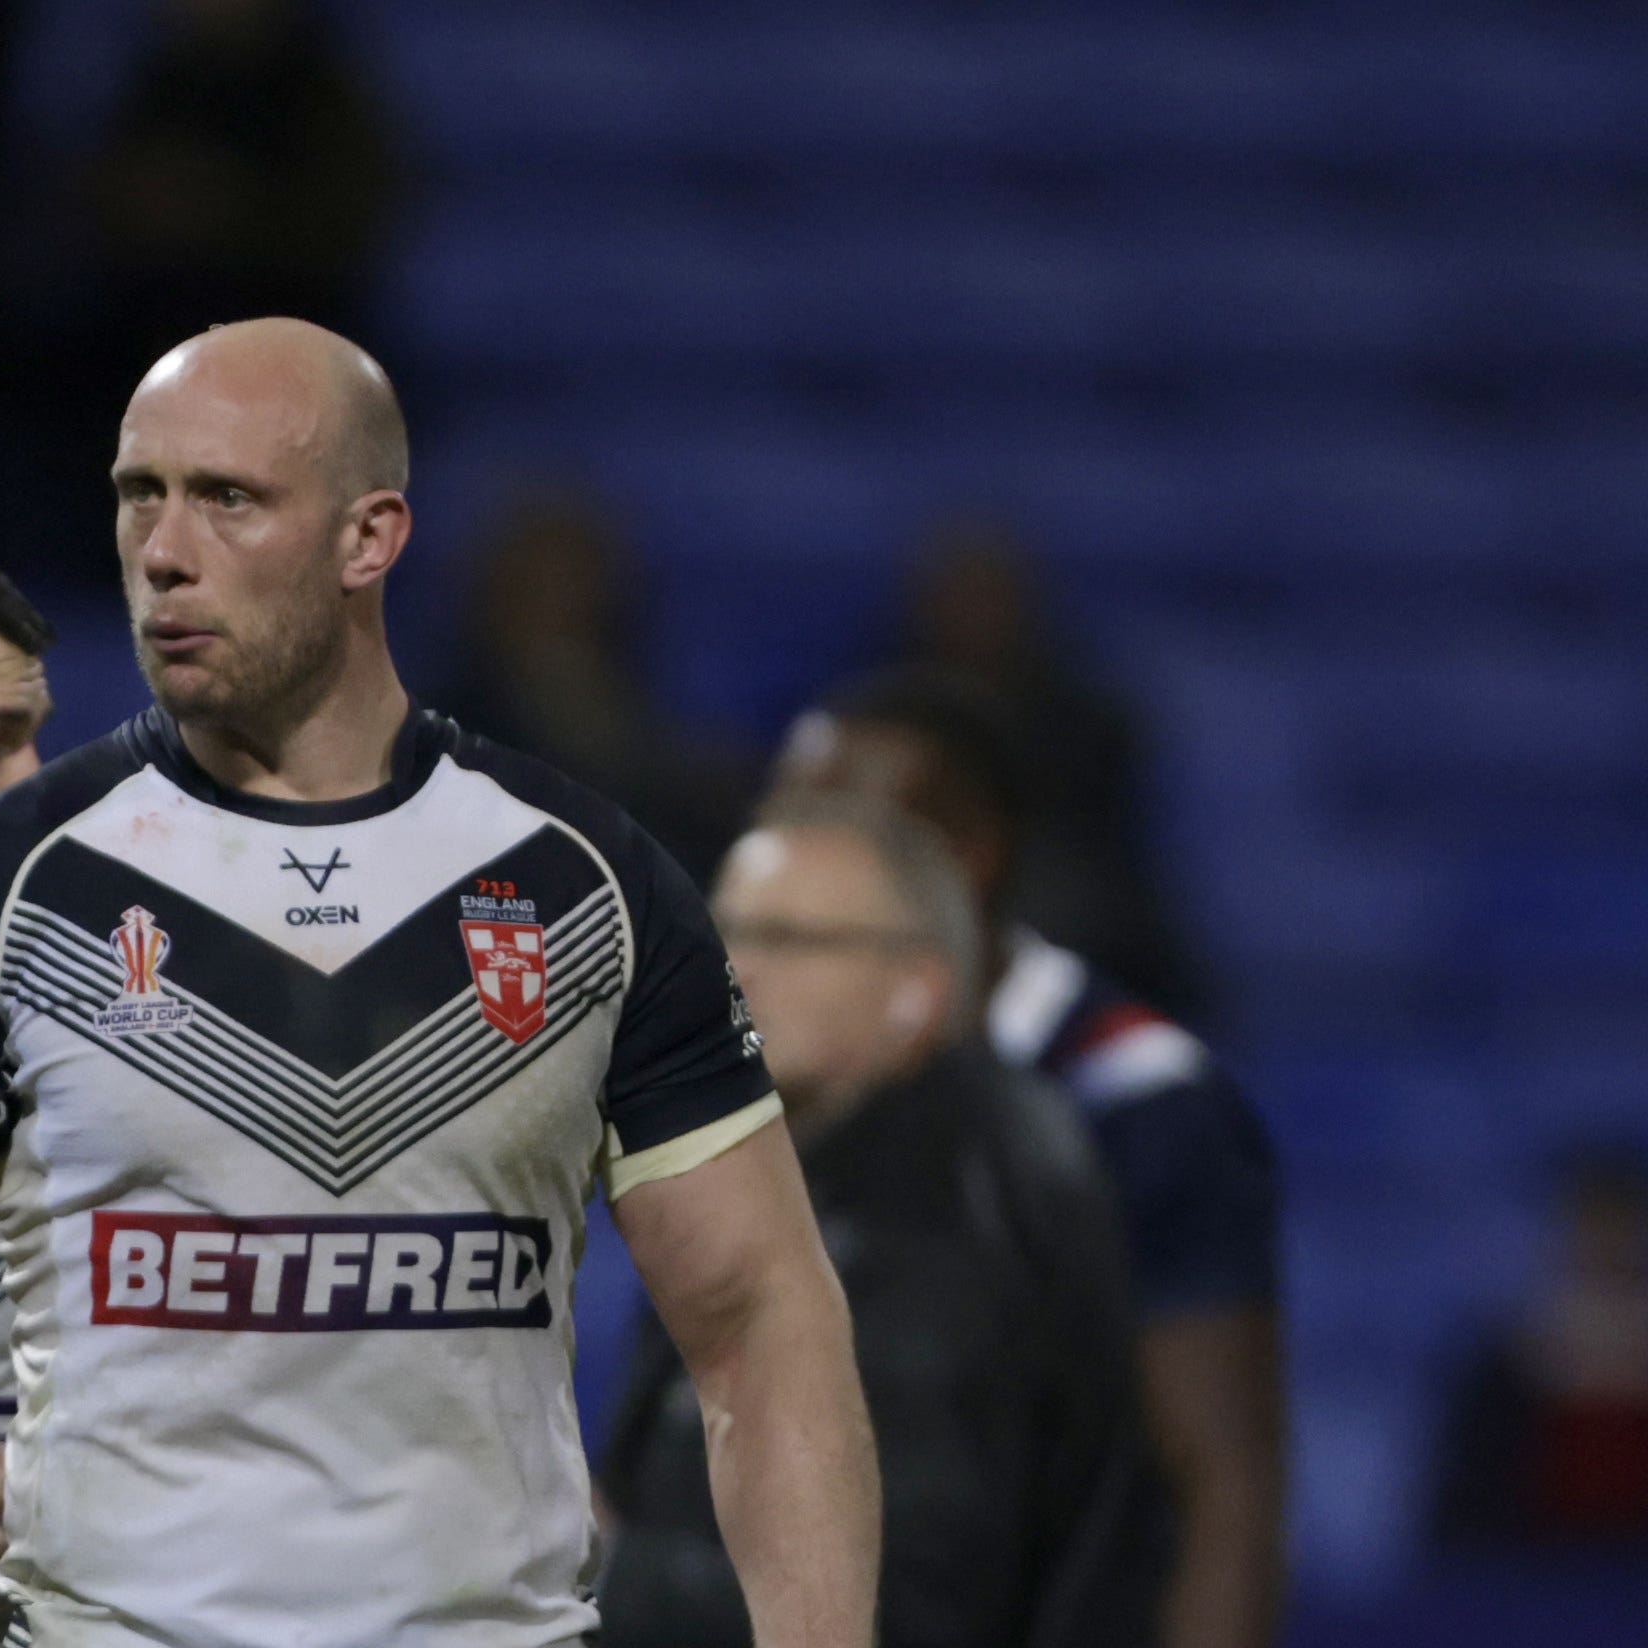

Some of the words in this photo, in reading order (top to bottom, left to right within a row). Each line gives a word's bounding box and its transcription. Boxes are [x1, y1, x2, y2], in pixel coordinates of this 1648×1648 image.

[474, 879, 517, 898] 713
[460, 894, 536, 913] ENGLAND
[285, 906, 359, 925] OXEN
[97, 1010, 153, 1026] WORLD
[157, 1008, 189, 1021] CUP
[106, 1229, 544, 1314] BETFRED
